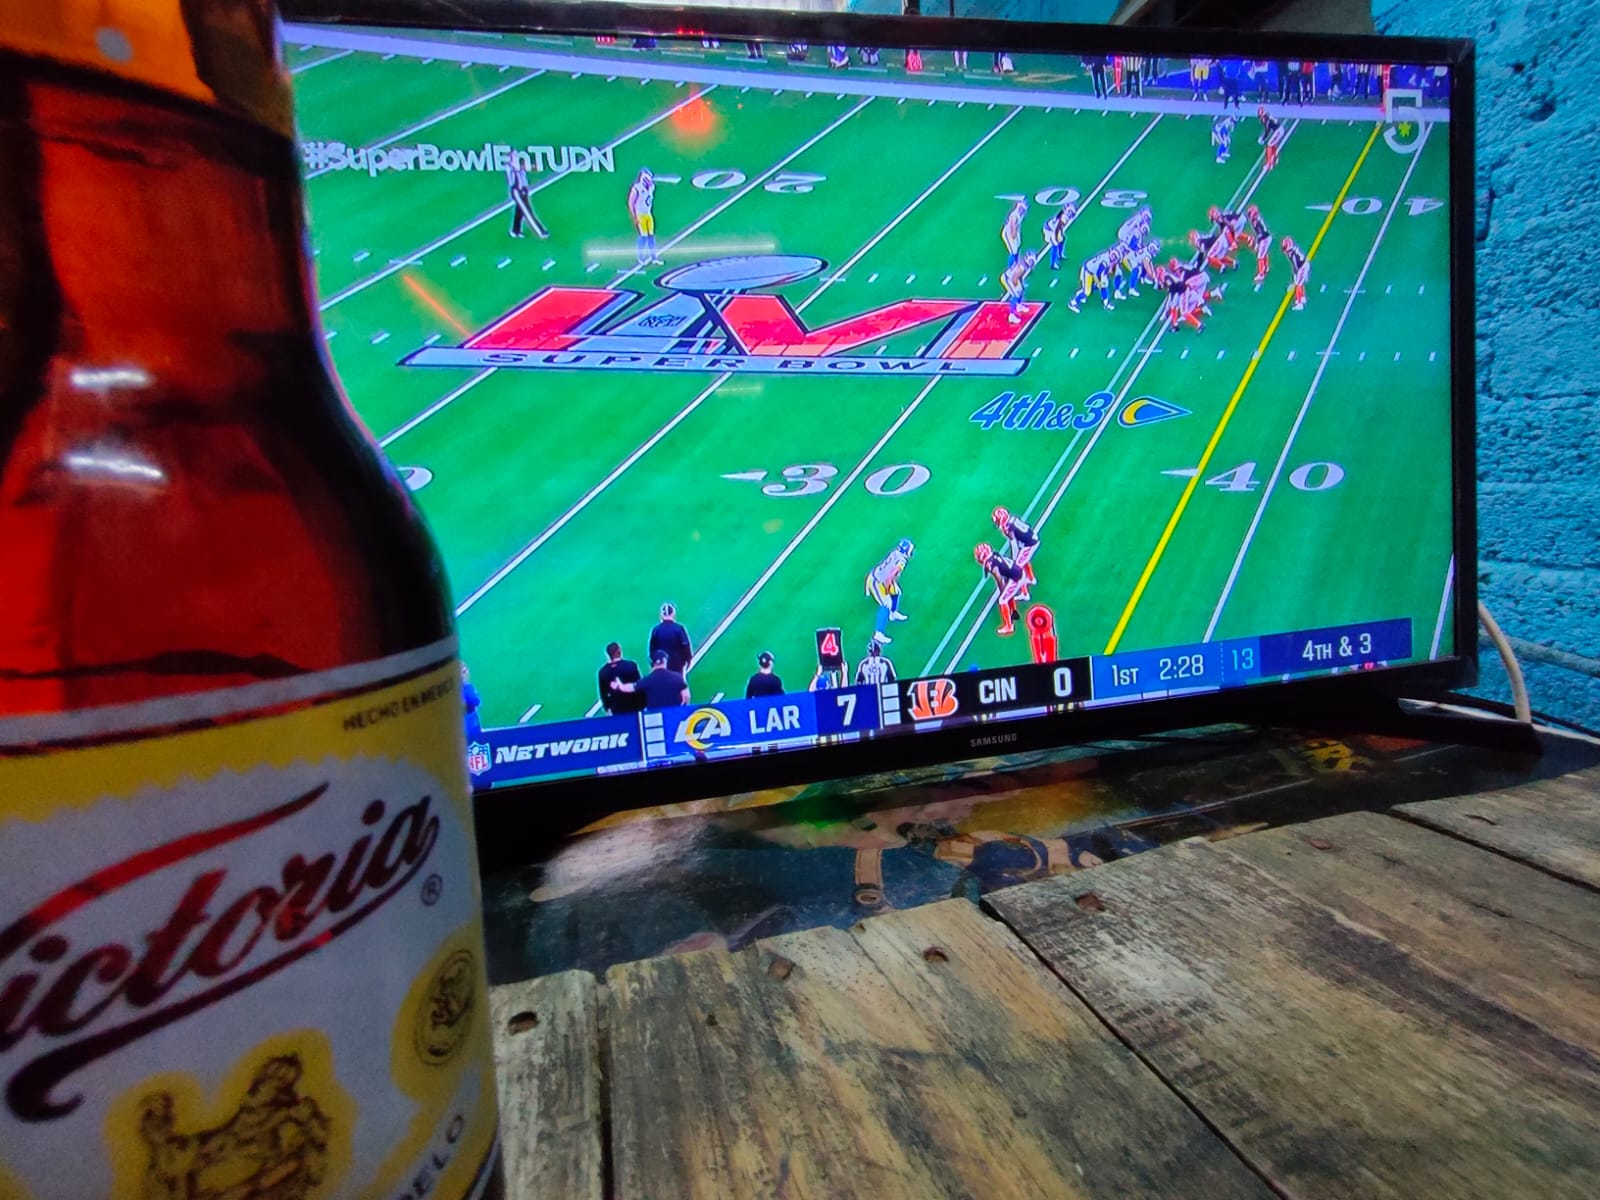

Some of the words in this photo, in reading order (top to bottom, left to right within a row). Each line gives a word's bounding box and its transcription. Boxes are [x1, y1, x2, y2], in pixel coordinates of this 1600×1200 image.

[303, 142, 616, 177] #SuperBowlEnTUDN
[481, 351, 748, 370] SUPER
[775, 356, 968, 373] BOWL
[821, 632, 839, 656] 4
[1302, 639, 1333, 661] 4TH
[1339, 637, 1353, 657] &
[1359, 632, 1372, 655] 3
[1111, 663, 1140, 687] 1ST
[1159, 653, 1205, 681] 2:28
[1231, 647, 1254, 671] 13
[978, 676, 1017, 704] CIN
[1053, 667, 1073, 697] 0
[343, 700, 401, 731] HECHO
[749, 704, 801, 735] LAR
[836, 693, 857, 726] 7
[495, 732, 630, 764] NETWORK
[969, 732, 1018, 748] SAMSUNG
[0, 785, 441, 1060] ictoria
